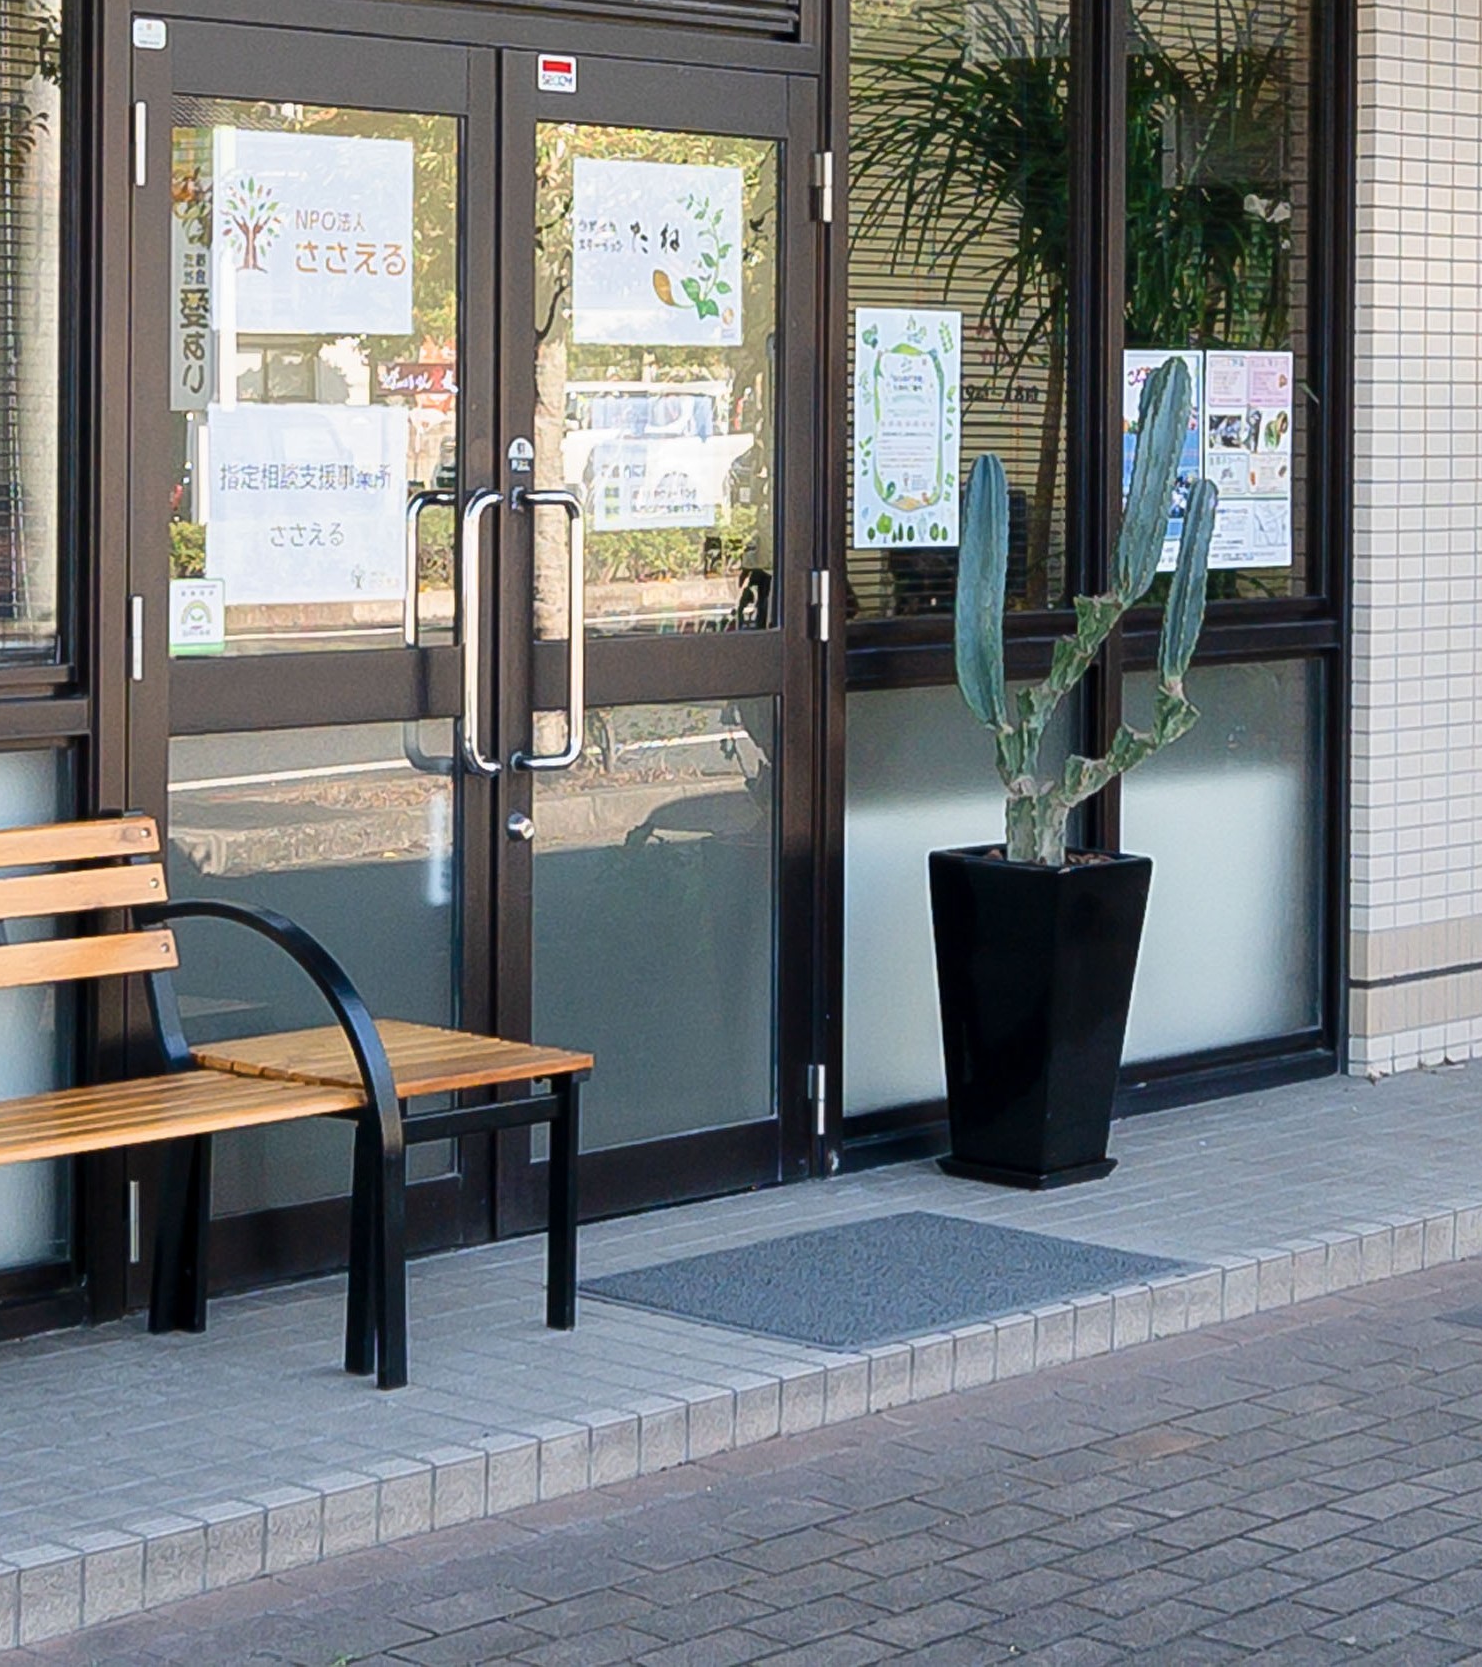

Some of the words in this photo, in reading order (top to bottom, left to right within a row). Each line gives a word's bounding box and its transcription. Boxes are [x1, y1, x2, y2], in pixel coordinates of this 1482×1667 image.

[295, 209, 366, 233] NPO法人
[295, 240, 407, 277] ささえる
[220, 463, 392, 491] 指定相談支援事業所
[270, 522, 345, 547] ささえる
